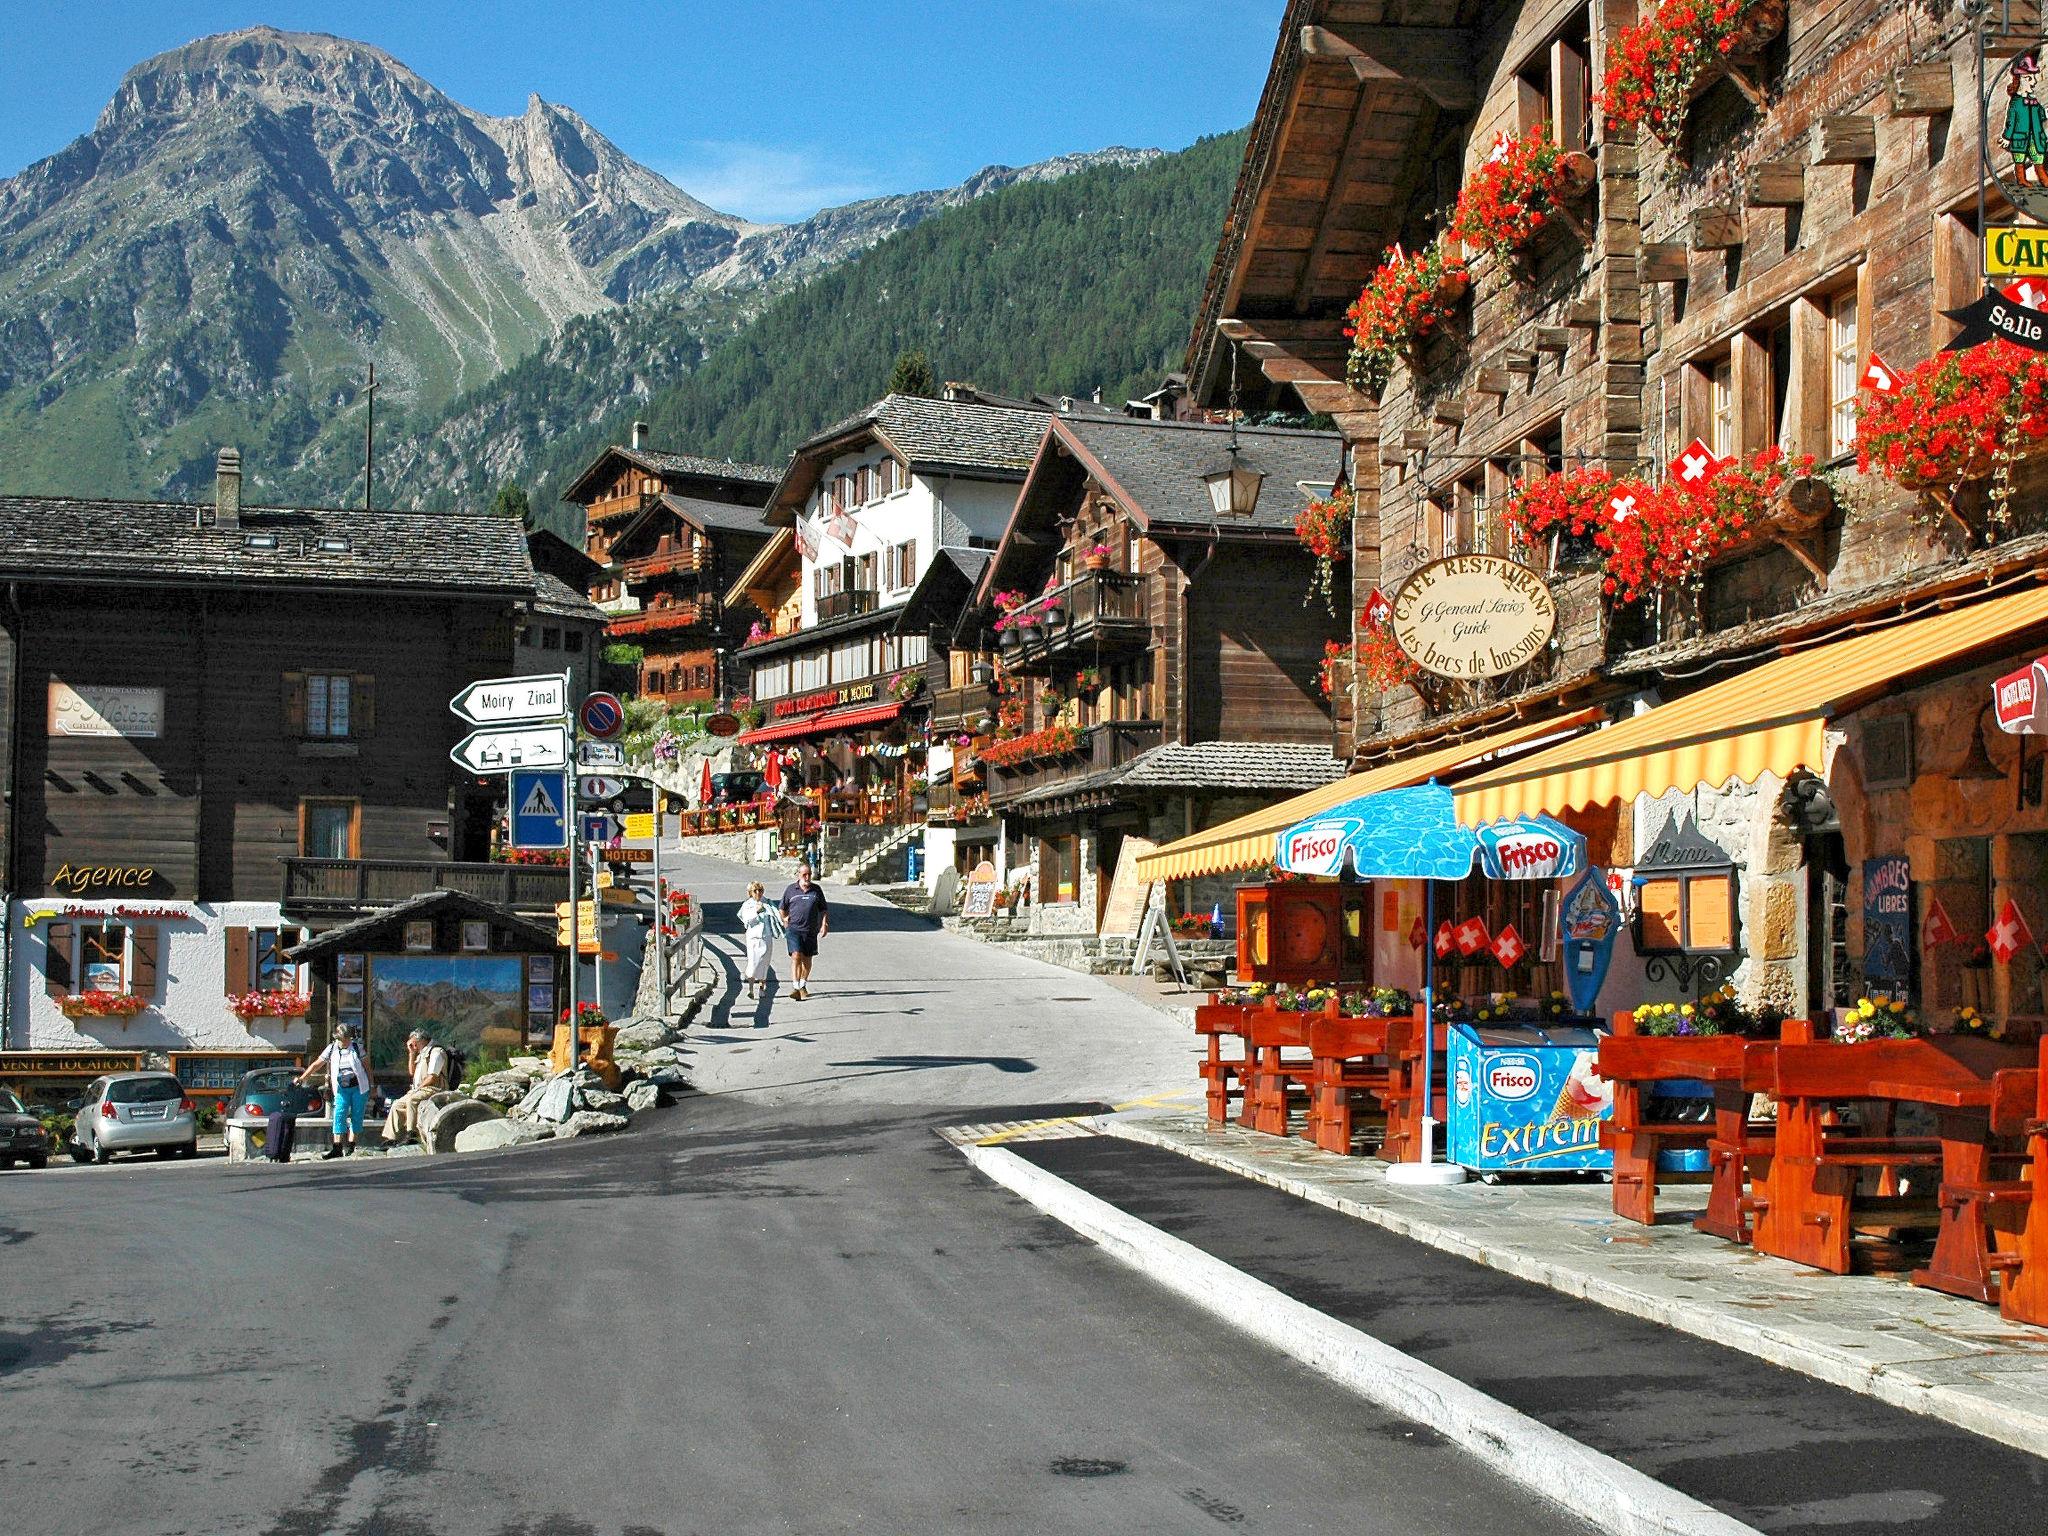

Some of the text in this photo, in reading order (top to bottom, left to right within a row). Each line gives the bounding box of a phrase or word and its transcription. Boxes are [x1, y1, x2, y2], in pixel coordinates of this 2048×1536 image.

[1988, 305, 2042, 340] Salle
[1395, 557, 1551, 621] CAFE RESTAURANT
[1452, 620, 1491, 642] Guide
[1400, 624, 1545, 674] les becs de bossons
[481, 689, 556, 711] Moiry Zinal
[605, 851, 648, 860] HOTELS
[1292, 836, 1337, 863] Frisco
[1497, 841, 1559, 872] Frisco
[1645, 840, 1716, 864] Menu
[51, 864, 153, 893] Agence
[1878, 895, 1908, 914] LIBRES
[2, 1058, 130, 1071] VENTE LOCATION
[1492, 1072, 1534, 1088] Frisco
[1480, 1115, 1600, 1158] Extrêm
